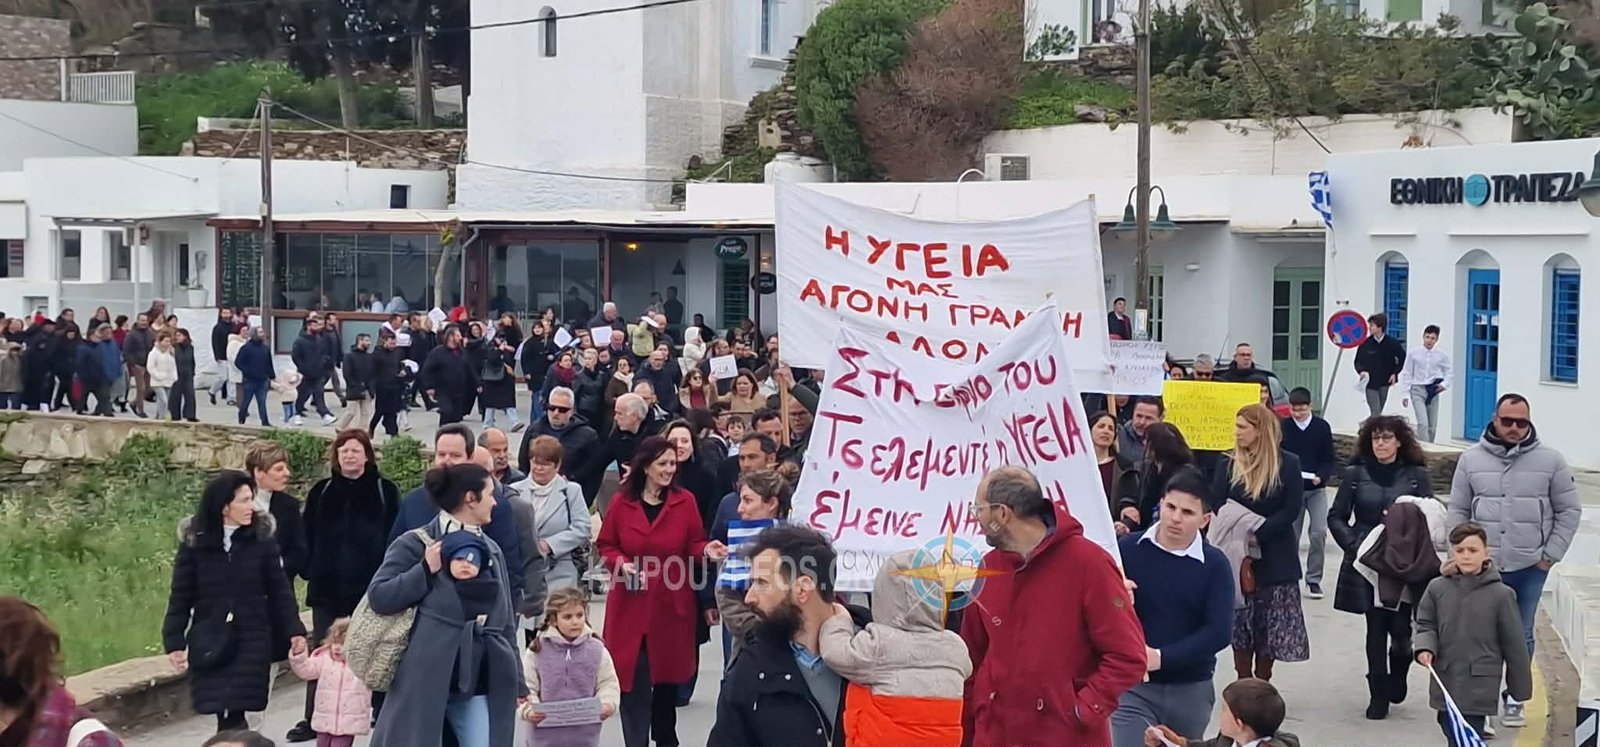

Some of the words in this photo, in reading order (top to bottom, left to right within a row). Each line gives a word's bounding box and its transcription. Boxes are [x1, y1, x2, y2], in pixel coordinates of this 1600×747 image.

[1390, 177, 1464, 205] ΕΘΝΙΚΗ
[824, 224, 850, 256] Η
[866, 234, 1010, 279] ΥΓΕΙΑ
[800, 278, 928, 322] ΑΓΟΝΗ
[948, 303, 1082, 338] ΓΡΑΗ
[886, 276, 959, 299] ΜΑΣ
[1001, 396, 1088, 468] ΥΓΕΙΑ
